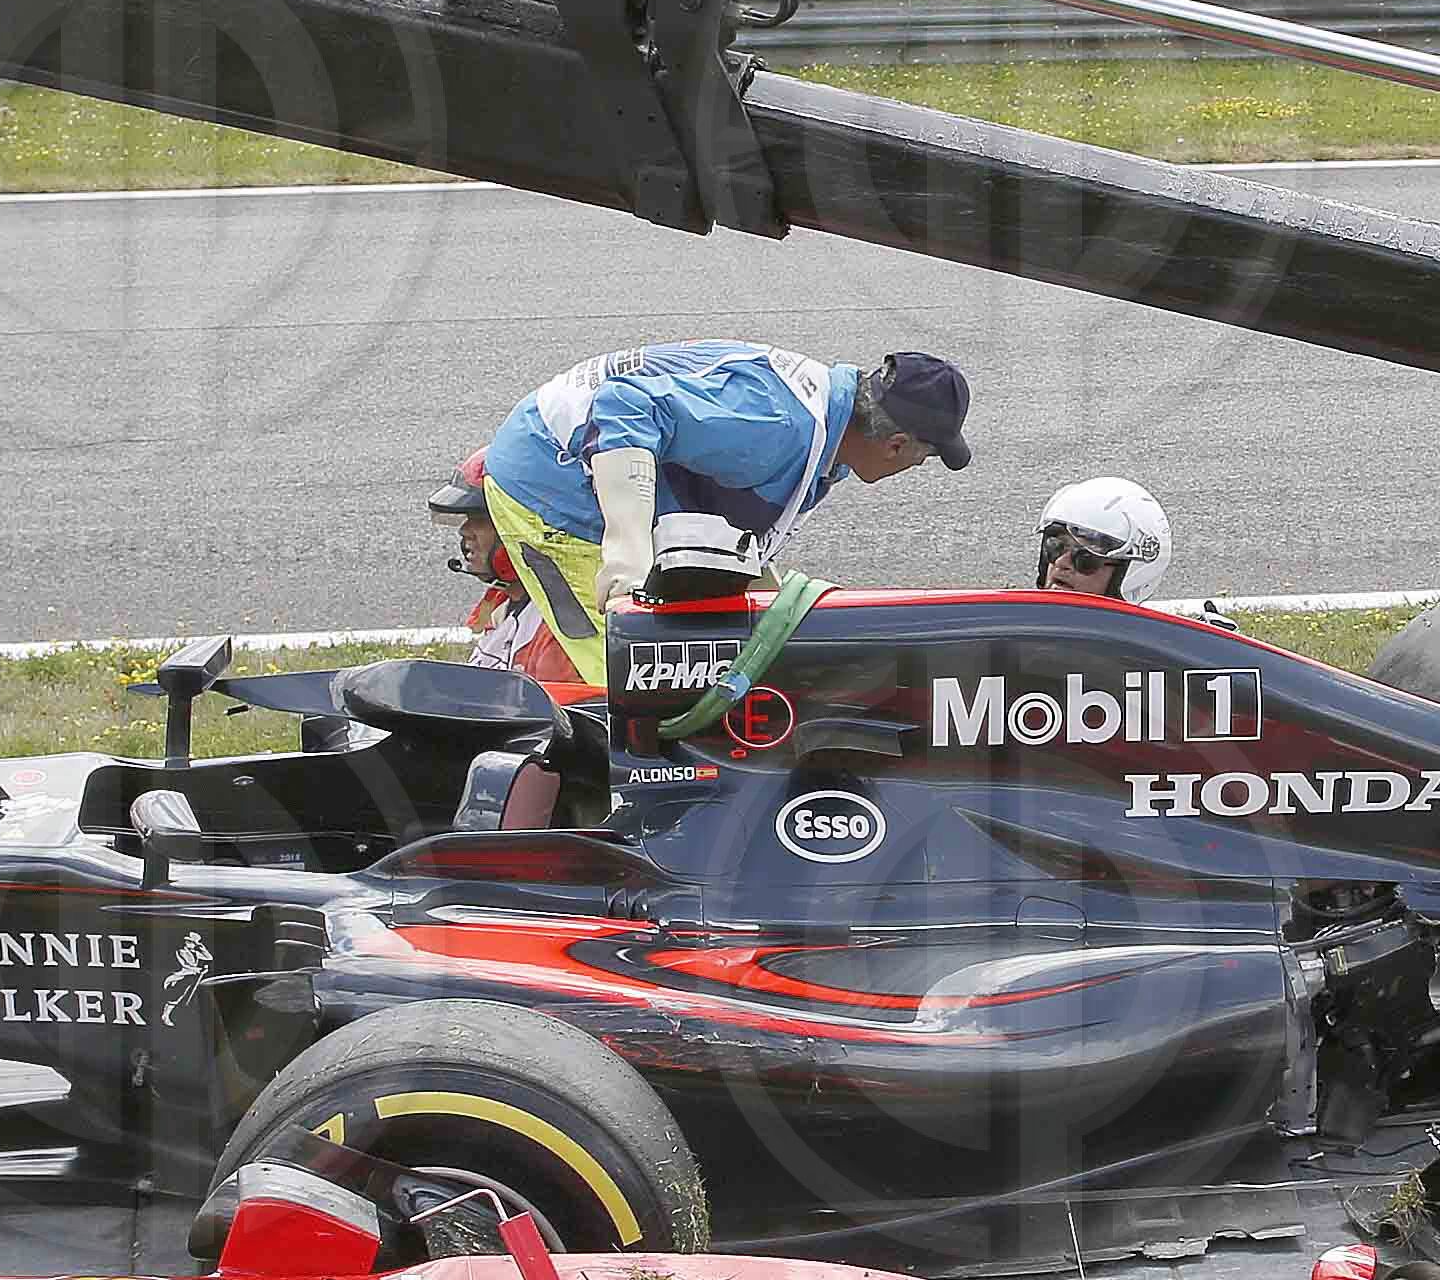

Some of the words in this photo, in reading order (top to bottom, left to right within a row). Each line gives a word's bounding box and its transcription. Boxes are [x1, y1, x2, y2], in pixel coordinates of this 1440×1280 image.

[745, 694, 773, 740] E
[932, 672, 1165, 747] Mobil
[1206, 675, 1233, 735] 1
[628, 766, 695, 784] ALONSO
